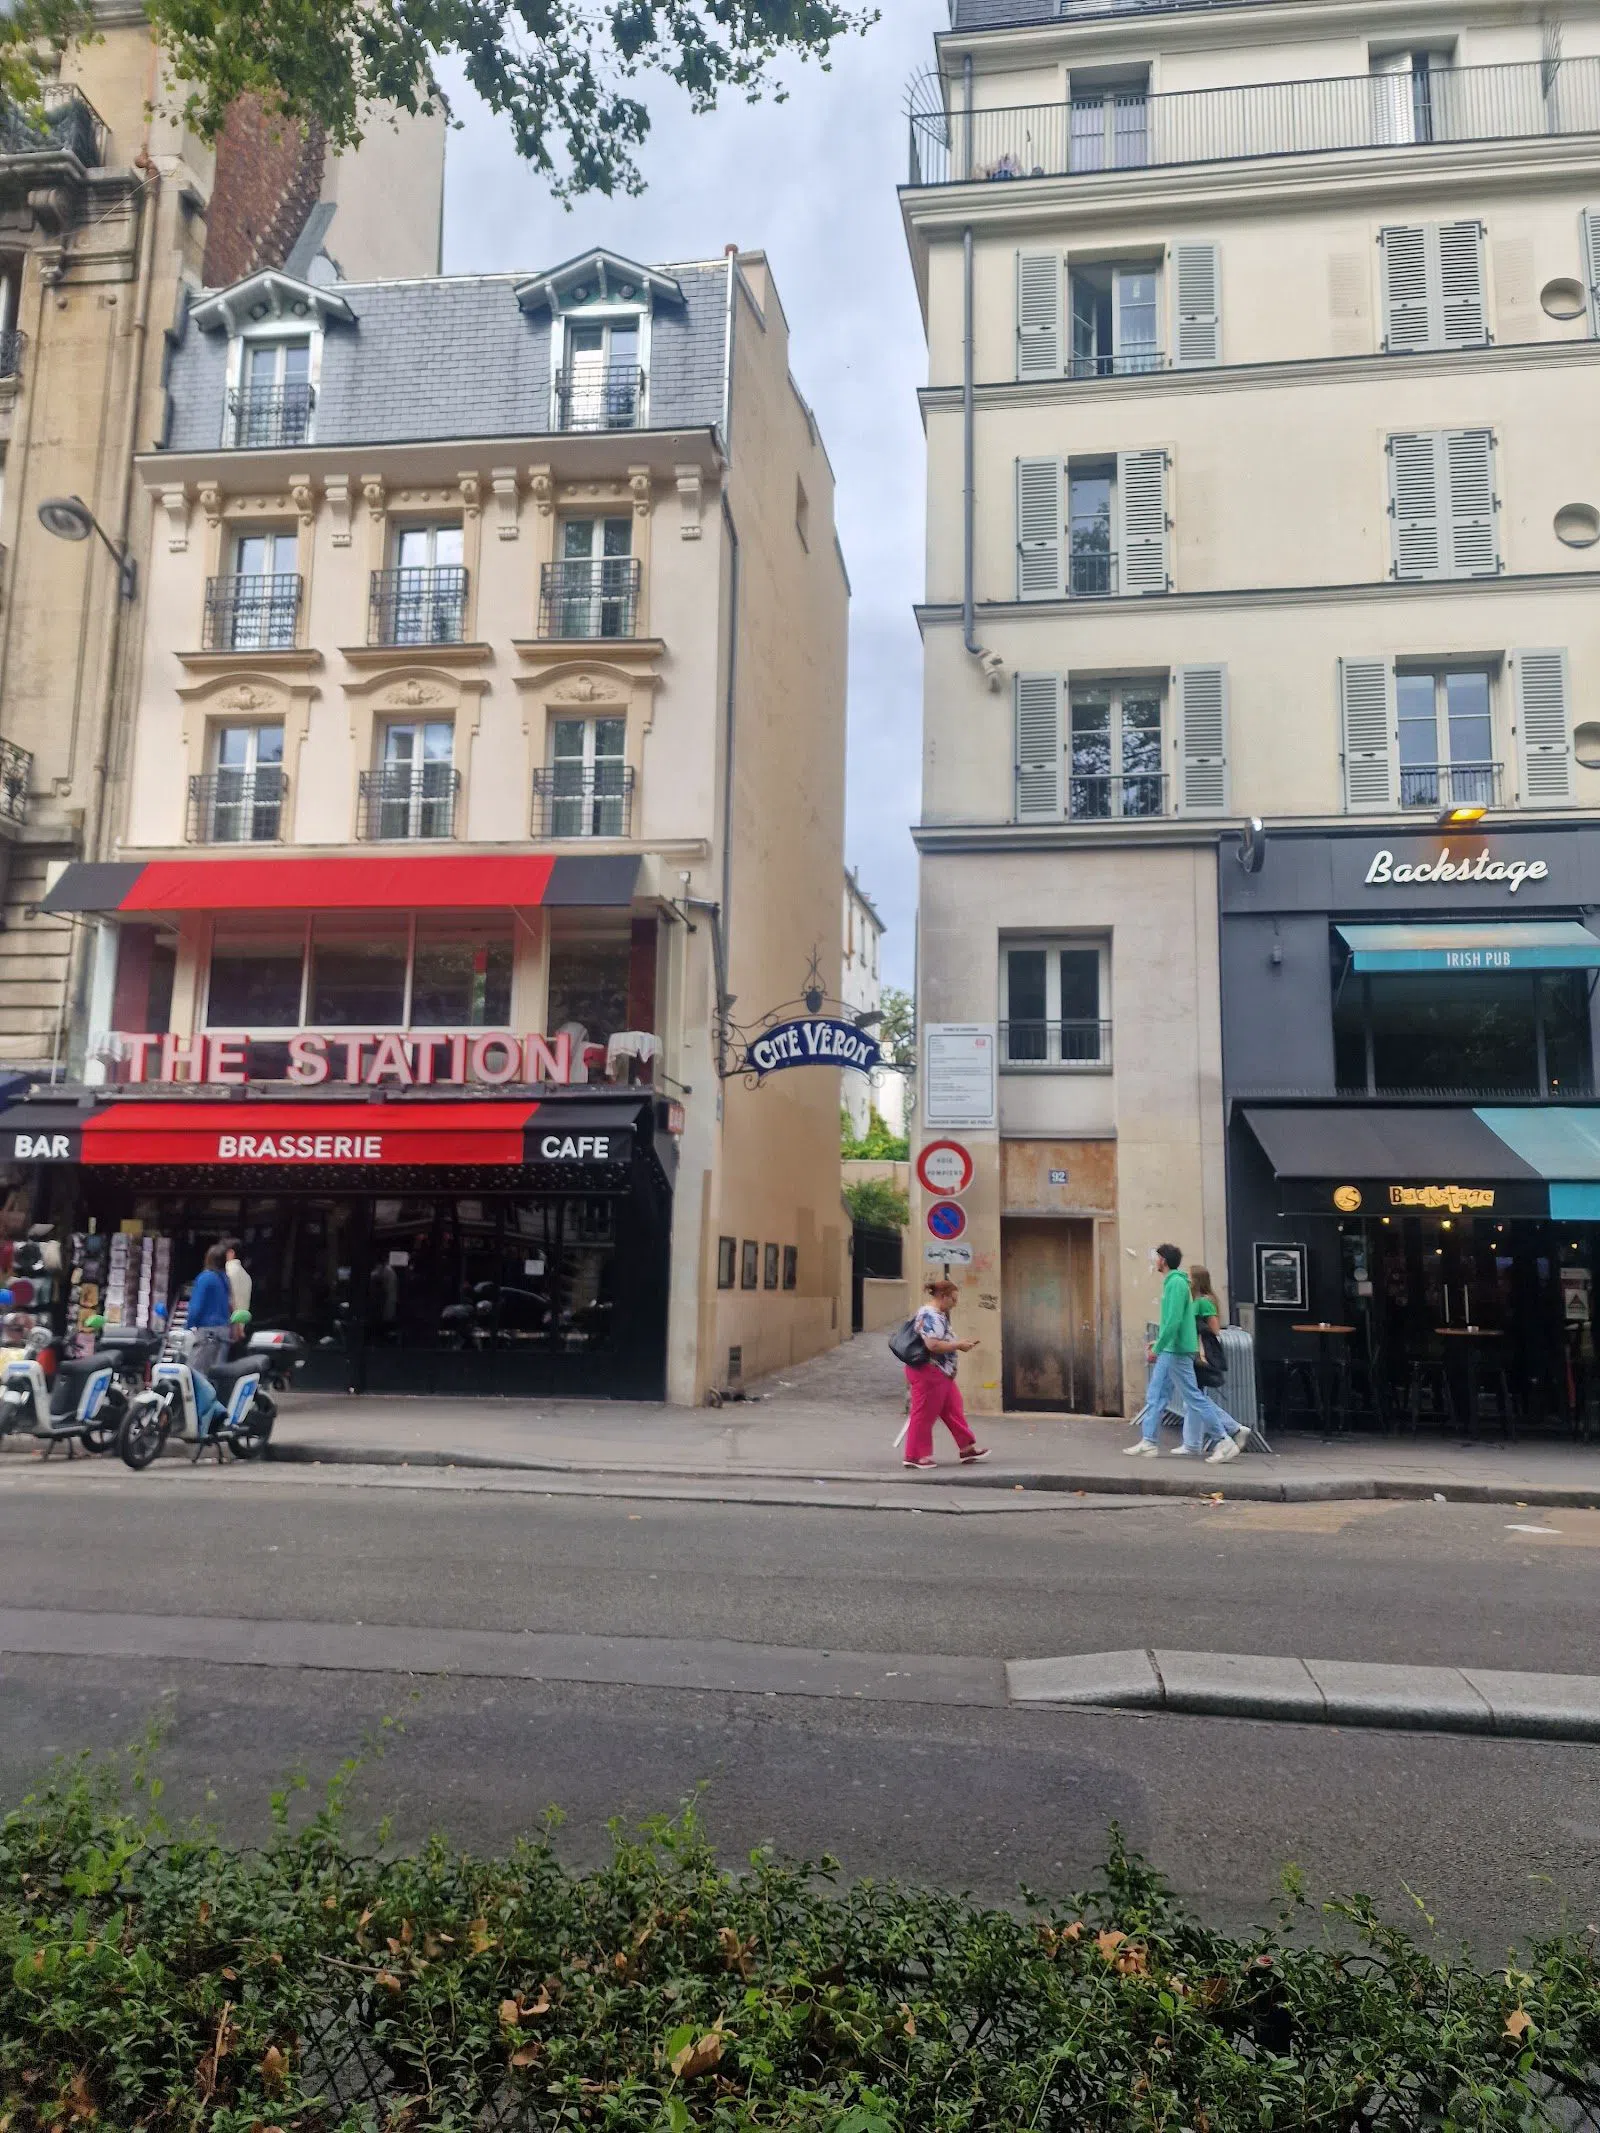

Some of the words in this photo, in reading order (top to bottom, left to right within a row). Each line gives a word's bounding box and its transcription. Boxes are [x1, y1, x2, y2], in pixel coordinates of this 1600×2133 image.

[1364, 847, 1549, 893] Backstage
[1446, 952, 1481, 967] IRISH
[1486, 951, 1511, 966] PUB
[753, 1026, 803, 1070] CITÉ
[802, 1021, 875, 1066] VÉRON
[120, 1032, 251, 1084] THE
[287, 1031, 572, 1086] STATION
[14, 1134, 70, 1159] BAR
[218, 1136, 382, 1159] BRASSERIE
[541, 1135, 610, 1159] CAFE
[1051, 1171, 1066, 1183] 92
[1391, 1186, 1493, 1210] Backstage
